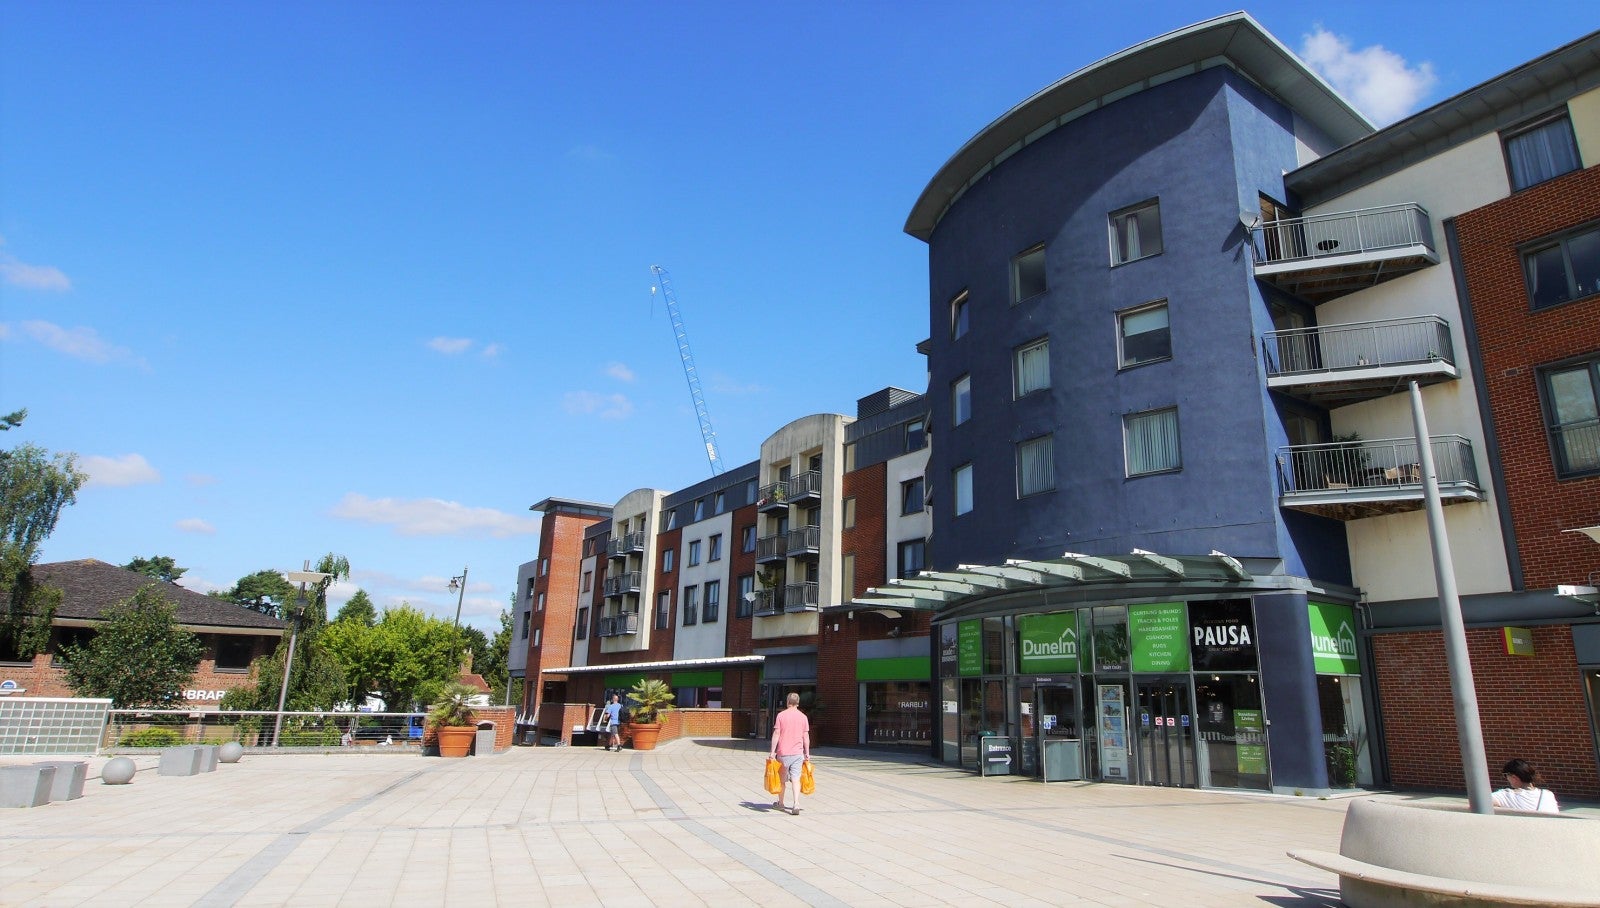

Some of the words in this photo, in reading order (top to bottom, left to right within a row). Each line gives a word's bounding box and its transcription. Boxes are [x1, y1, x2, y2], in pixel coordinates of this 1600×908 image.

[1023, 636, 1076, 655] Dunelm
[1194, 625, 1251, 646] PAUSA
[1311, 630, 1354, 654] unelm
[988, 744, 1012, 752] Entrance
